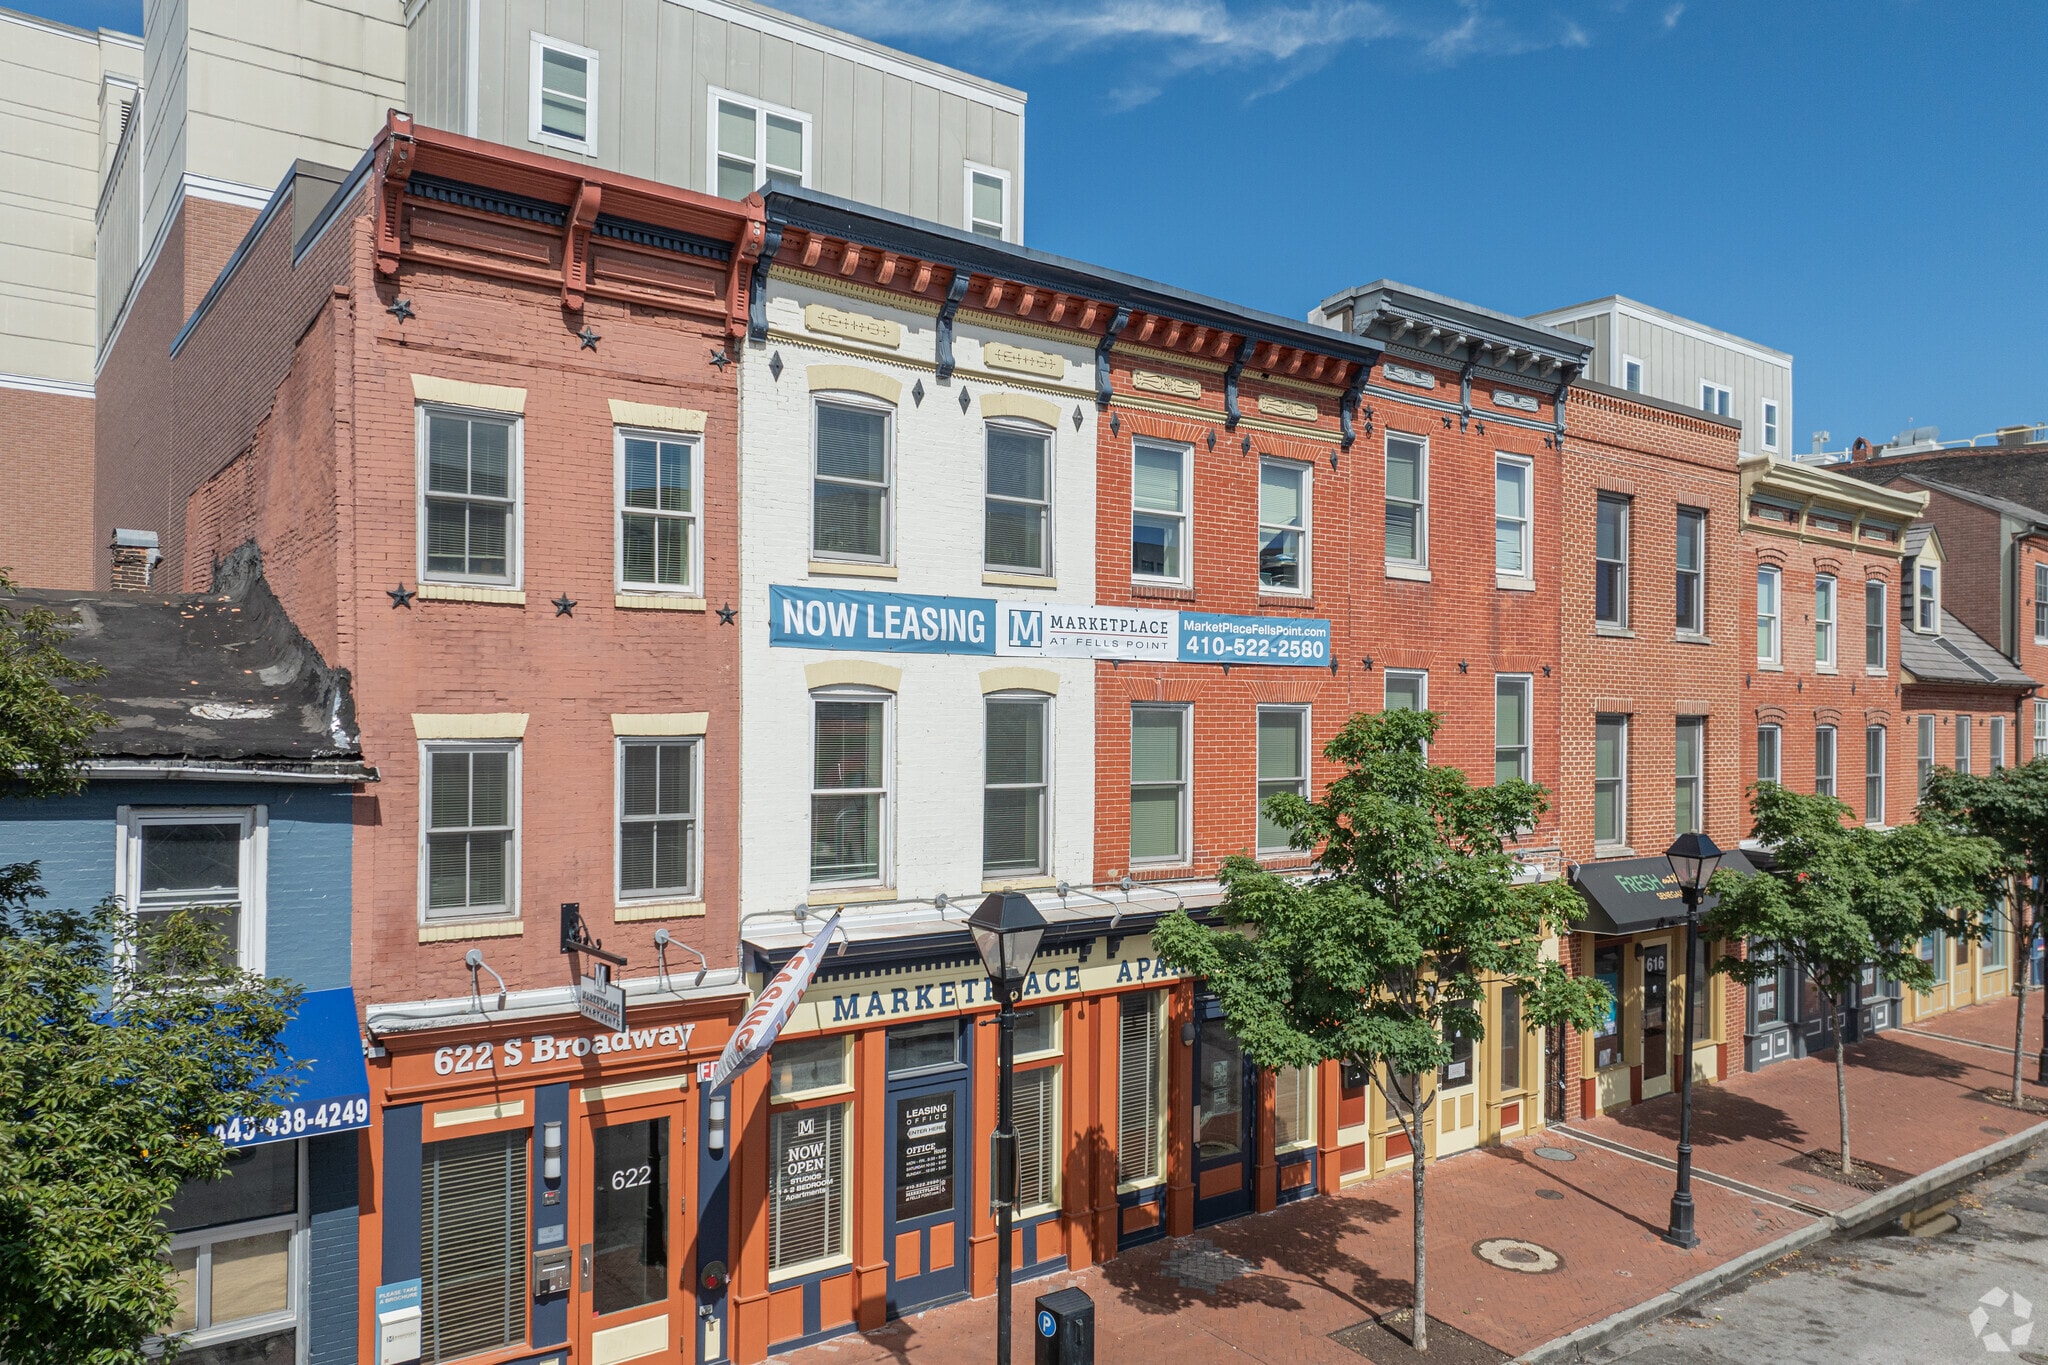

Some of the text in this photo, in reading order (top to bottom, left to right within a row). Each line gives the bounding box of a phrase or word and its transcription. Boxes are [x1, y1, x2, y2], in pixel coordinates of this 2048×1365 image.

[783, 599, 985, 643] NOW LEASING
[1010, 612, 1041, 647] M
[1050, 615, 1168, 634] MARKETPLACE
[1184, 620, 1326, 637] MarketPlaceFellsPoint.com
[1050, 637, 1168, 650] AT FELLS POINT
[1186, 636, 1324, 658] 410-522-2580
[1614, 874, 1665, 893] FRESH
[1646, 955, 1665, 972] 616
[832, 966, 1080, 1021] MARKETACE
[434, 1023, 695, 1075] 622 S Broadway
[906, 1104, 947, 1118] LEASING
[906, 1113, 947, 1126] OFFICE
[799, 1119, 814, 1135] M
[909, 1128, 927, 1136] ENTER
[788, 1143, 824, 1162] NOW
[906, 1143, 936, 1155] OFFICE
[788, 1157, 824, 1175] OPEN
[612, 1165, 651, 1190] 622
[790, 1173, 822, 1184] STUDIOS
[796, 1178, 833, 1192] BEDROOM
[785, 1188, 827, 1201] Apartments
[379, 1288, 401, 1299] PLEASE
[385, 1291, 418, 1303] BROCHURE
[1042, 1315, 1052, 1332] P
